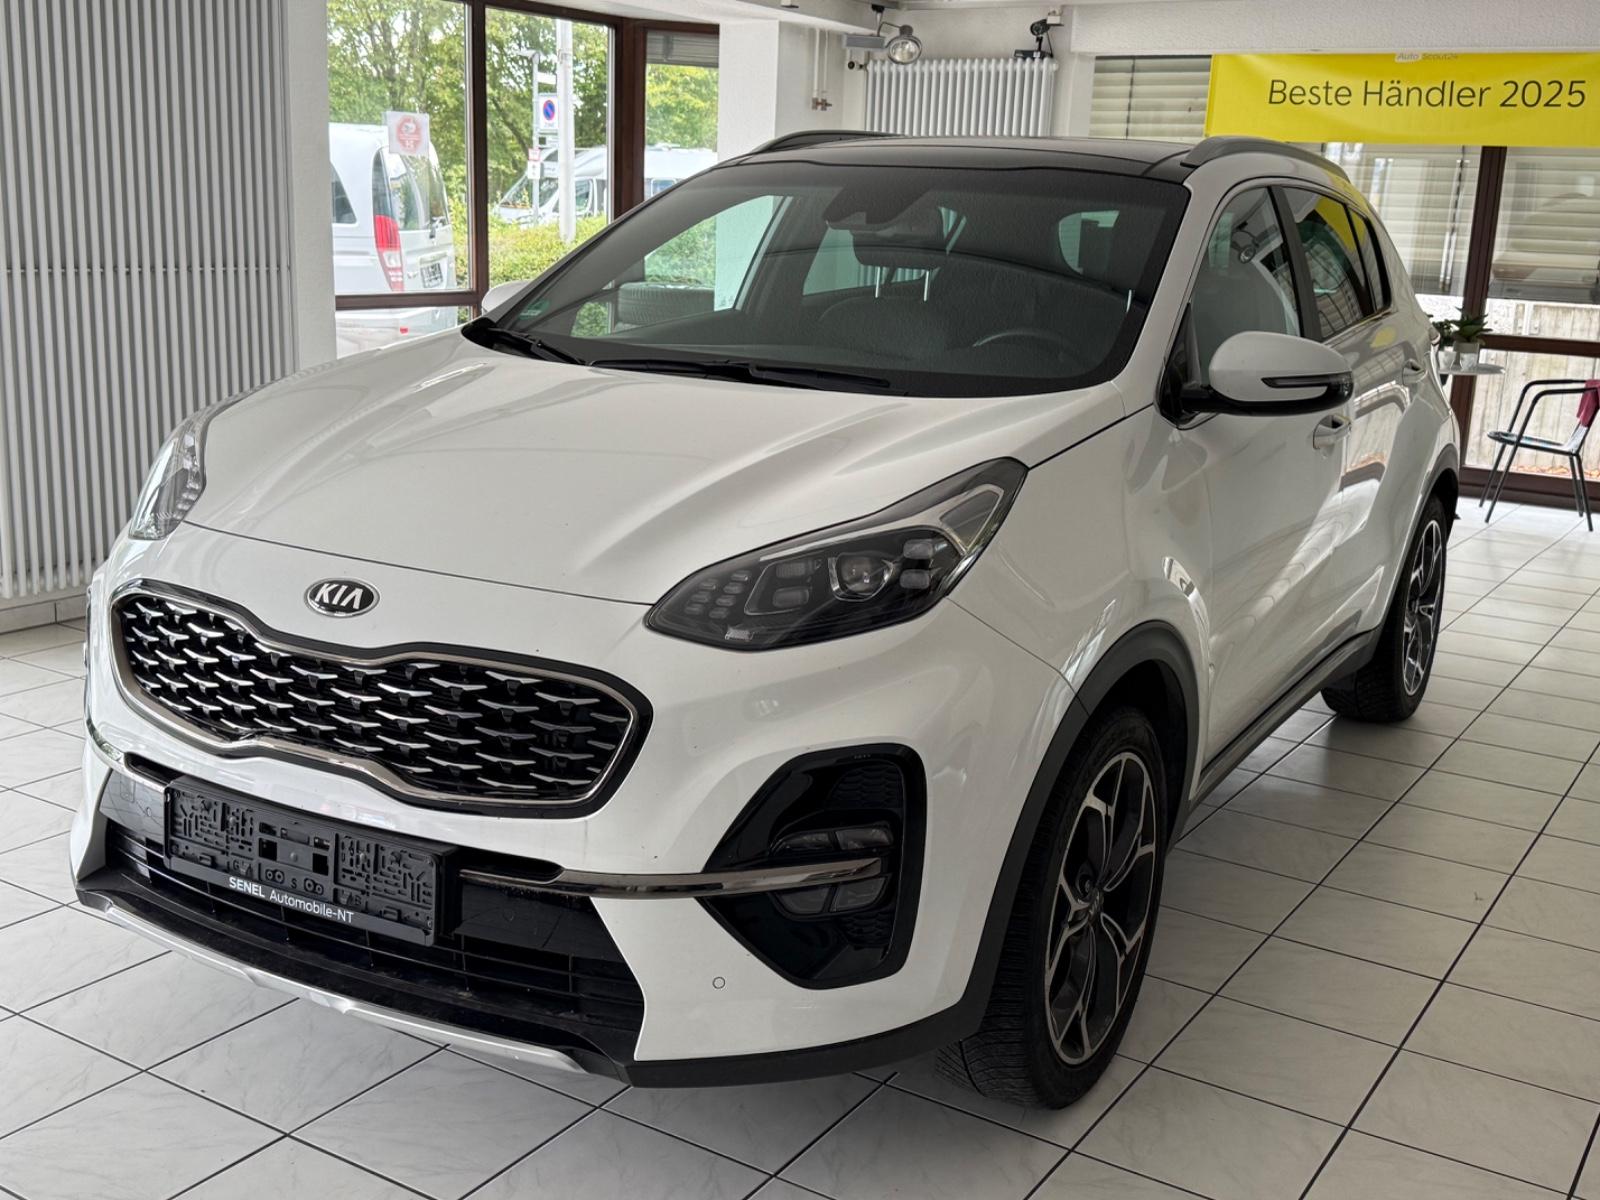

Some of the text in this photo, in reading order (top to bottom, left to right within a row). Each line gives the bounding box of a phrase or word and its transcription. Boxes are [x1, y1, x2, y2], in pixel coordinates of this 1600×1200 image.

[1268, 79, 1586, 108] Beste Händler 2025
[314, 583, 364, 609] KIA
[229, 876, 354, 922] SENEL Automobile-NT
